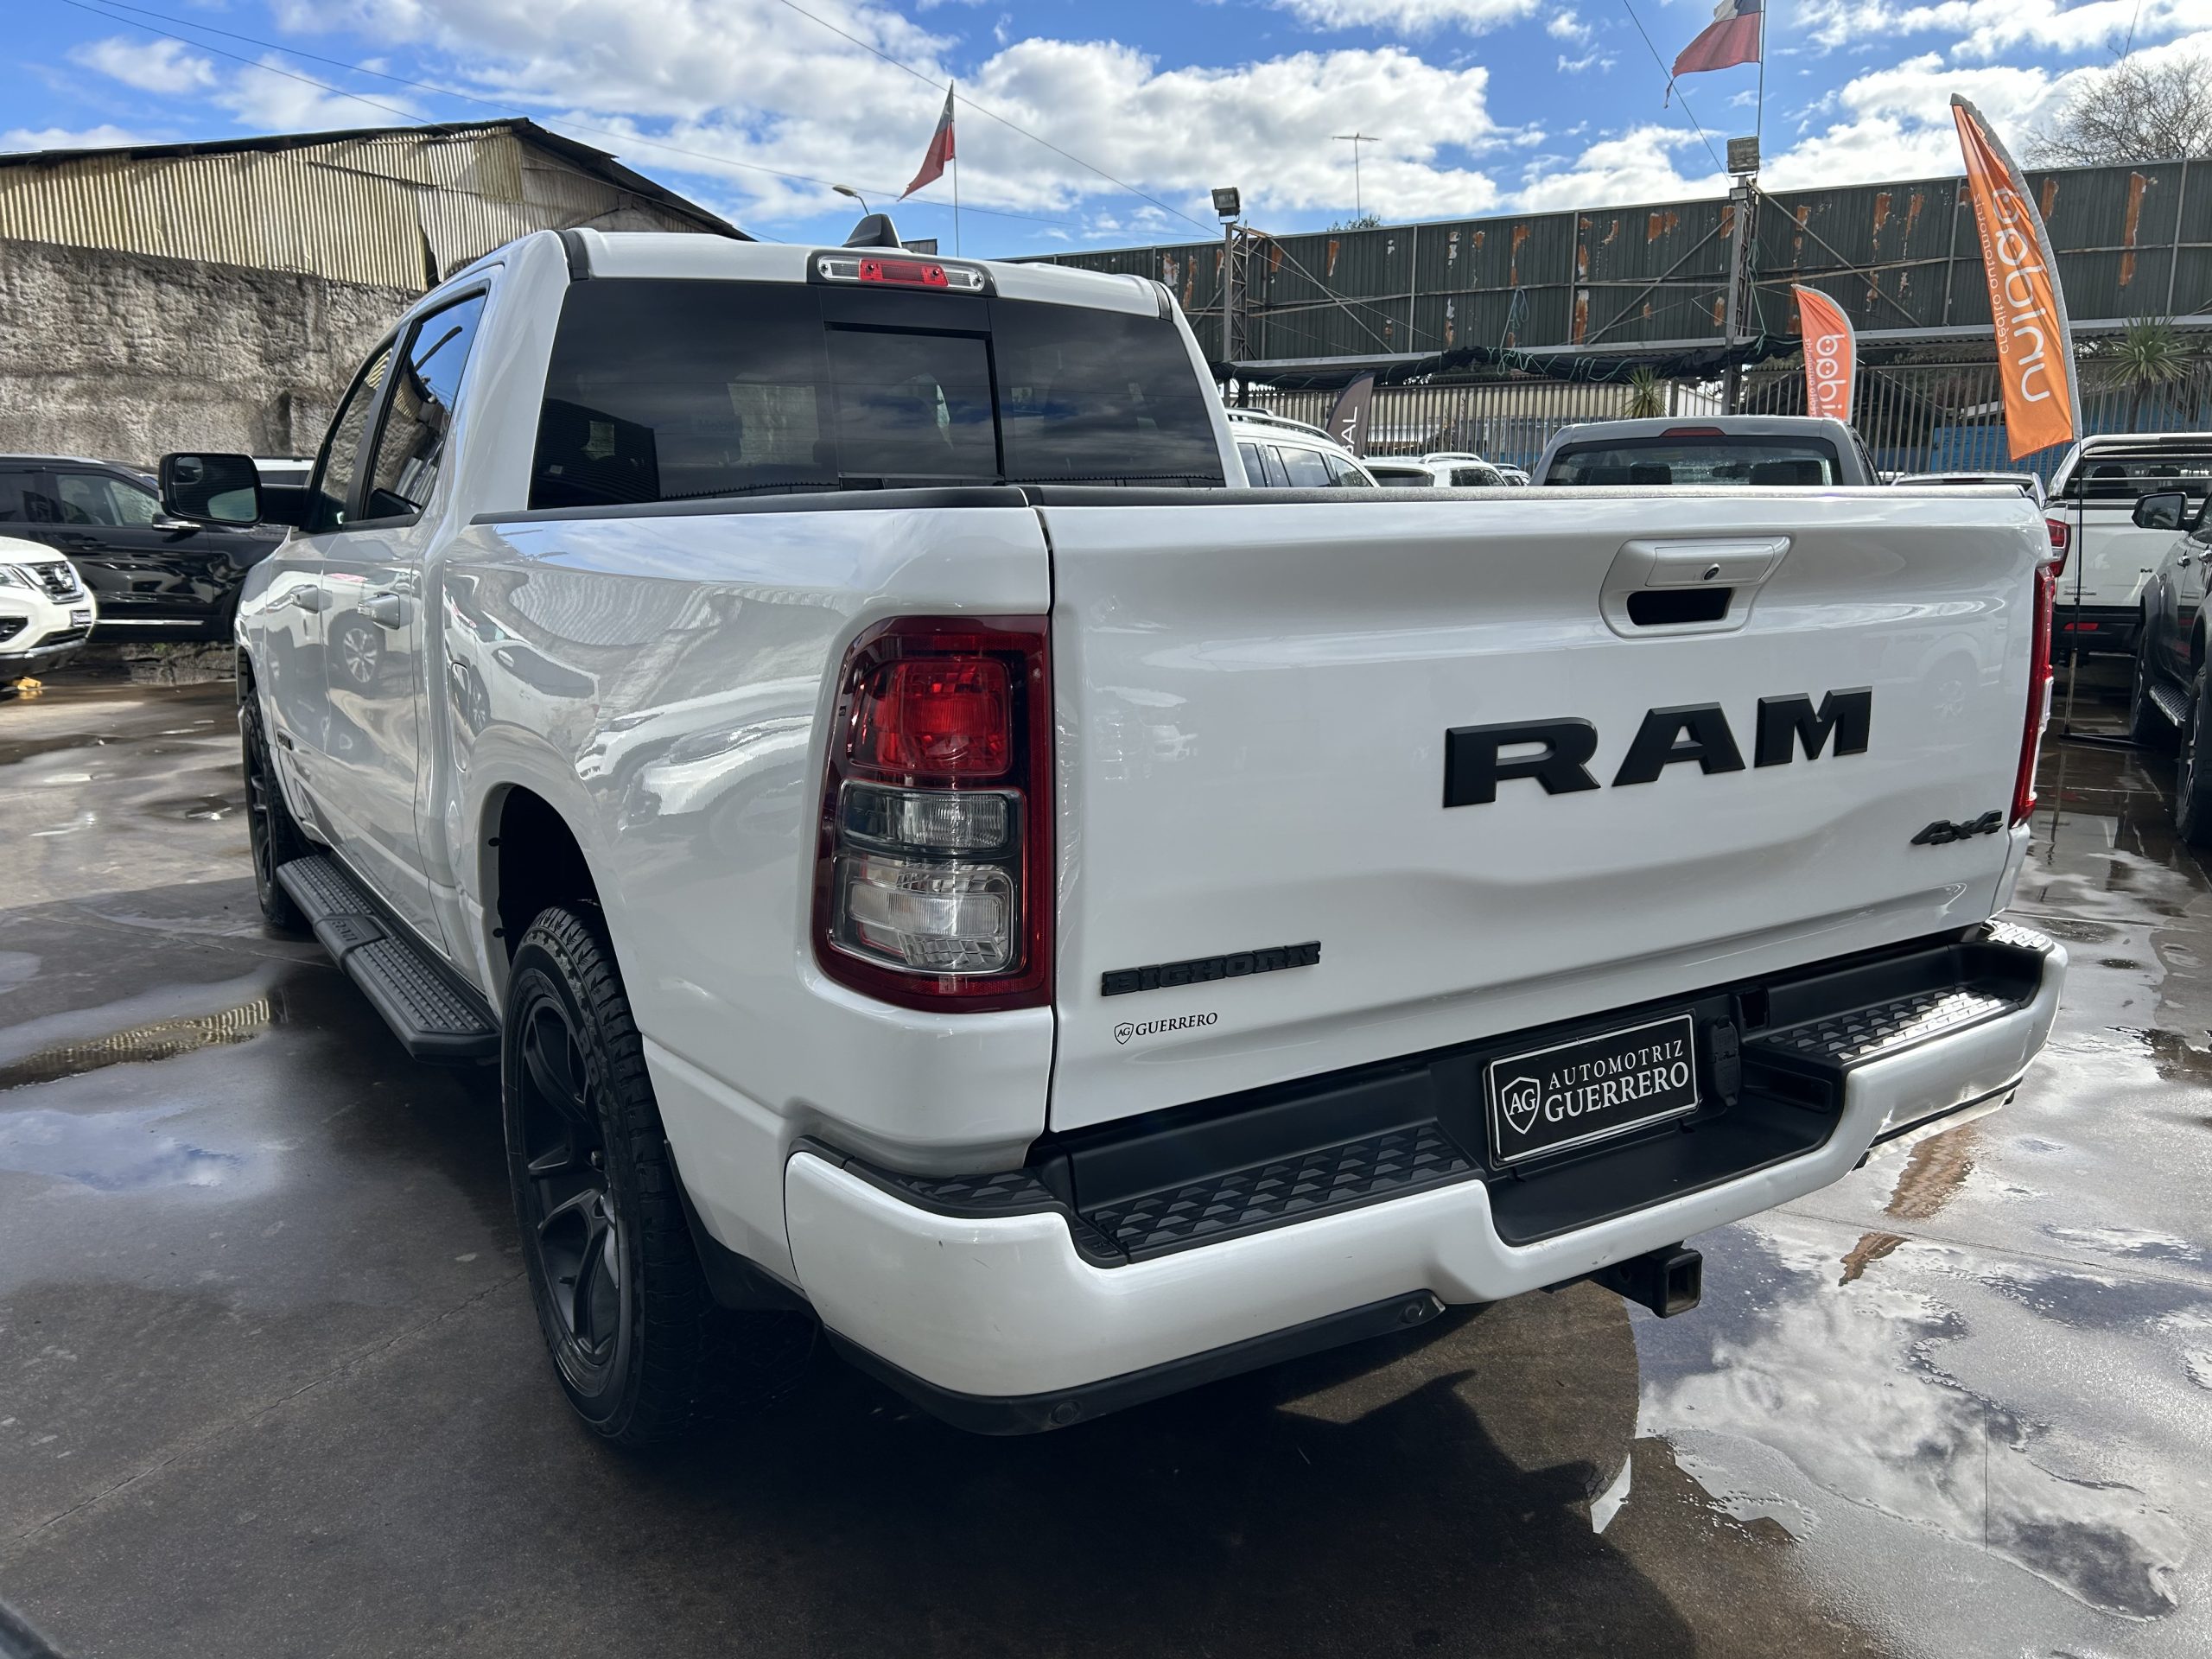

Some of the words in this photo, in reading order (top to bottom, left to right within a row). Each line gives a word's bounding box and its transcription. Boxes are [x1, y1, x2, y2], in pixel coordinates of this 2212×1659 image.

[1443, 686, 1872, 808] RAM
[1101, 940, 1321, 996] BIGHORN
[1117, 1027, 1130, 1037] AG
[1135, 1012, 1217, 1035] GUERRERO
[1509, 1088, 1536, 1116] AG
[1544, 1061, 1689, 1122] GUERRERO
[1548, 1039, 1683, 1090] AUTOMOTRIZ
